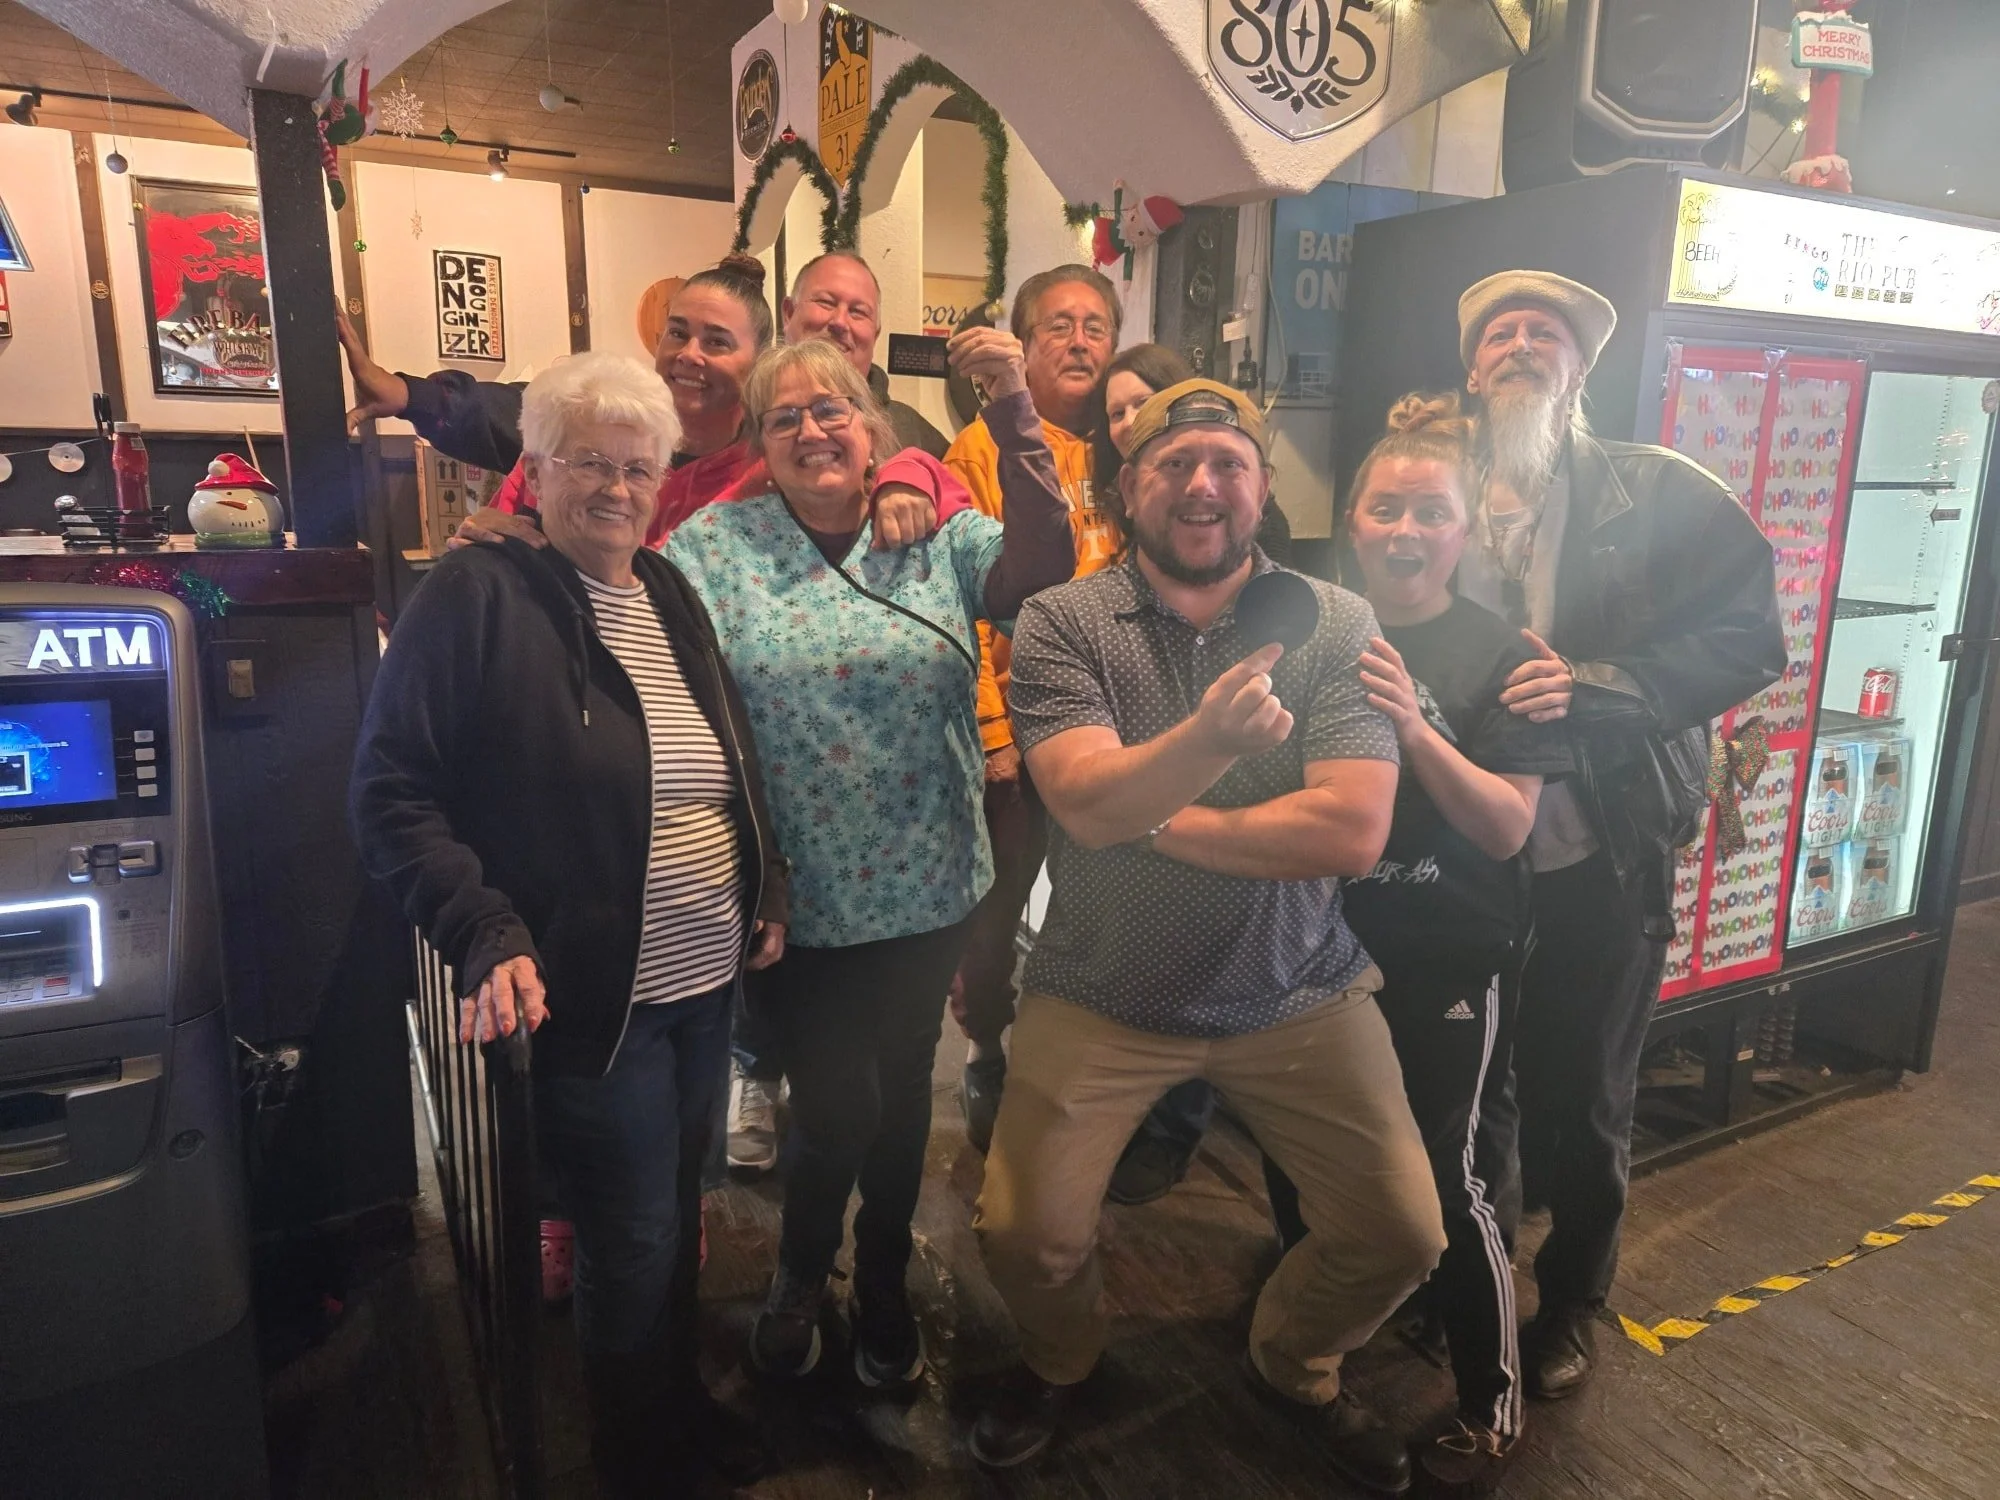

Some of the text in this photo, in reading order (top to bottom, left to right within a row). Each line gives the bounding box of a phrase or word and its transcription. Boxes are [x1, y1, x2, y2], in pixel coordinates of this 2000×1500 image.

[1220, 0, 1377, 87] 805
[1818, 30, 1861, 46] MERRY
[1803, 45, 1870, 64] CHRISTMAS
[821, 65, 866, 122] PALE
[835, 131, 850, 173] 31
[1297, 229, 1354, 264] BAR
[1838, 259, 1873, 283] RIO
[167, 309, 272, 351] FIREBA
[27, 626, 153, 669] ATM
[1808, 809, 1848, 833] Coors
[1811, 832, 1844, 845] LIGHT
[1797, 904, 1835, 928] Coors
[1444, 1012, 1475, 1020] adidas
